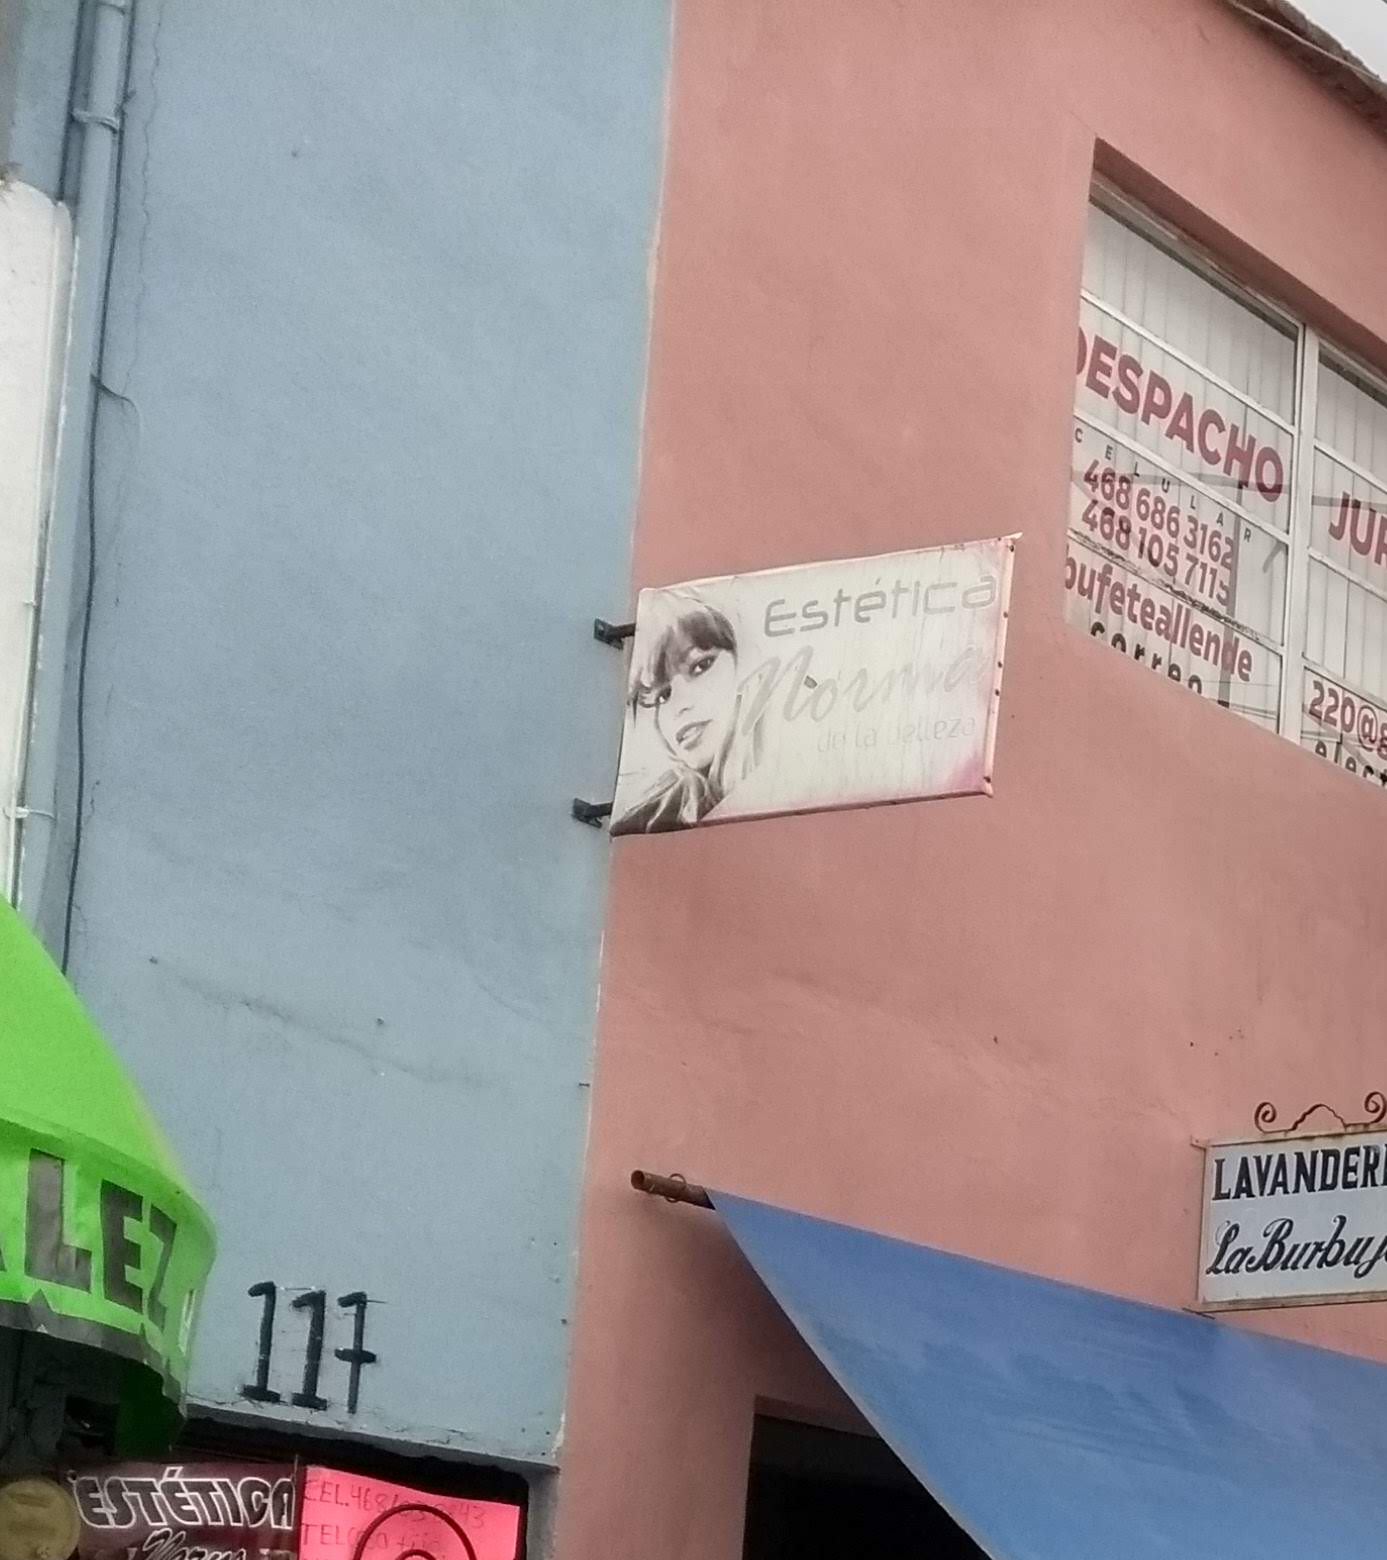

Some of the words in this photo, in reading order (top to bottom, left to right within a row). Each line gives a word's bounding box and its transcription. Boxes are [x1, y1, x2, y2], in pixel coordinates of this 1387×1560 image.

[1074, 428, 1252, 543] CELULAR
[1083, 459, 1131, 510] 468
[1136, 488, 1180, 538] 686
[1082, 500, 1131, 550] 468
[1137, 527, 1180, 577] 105
[764, 574, 997, 638] Estética
[0, 1148, 178, 1334] LEZ
[1205, 1220, 1253, 1275] La
[74, 1466, 296, 1530] ESTÉTICA
